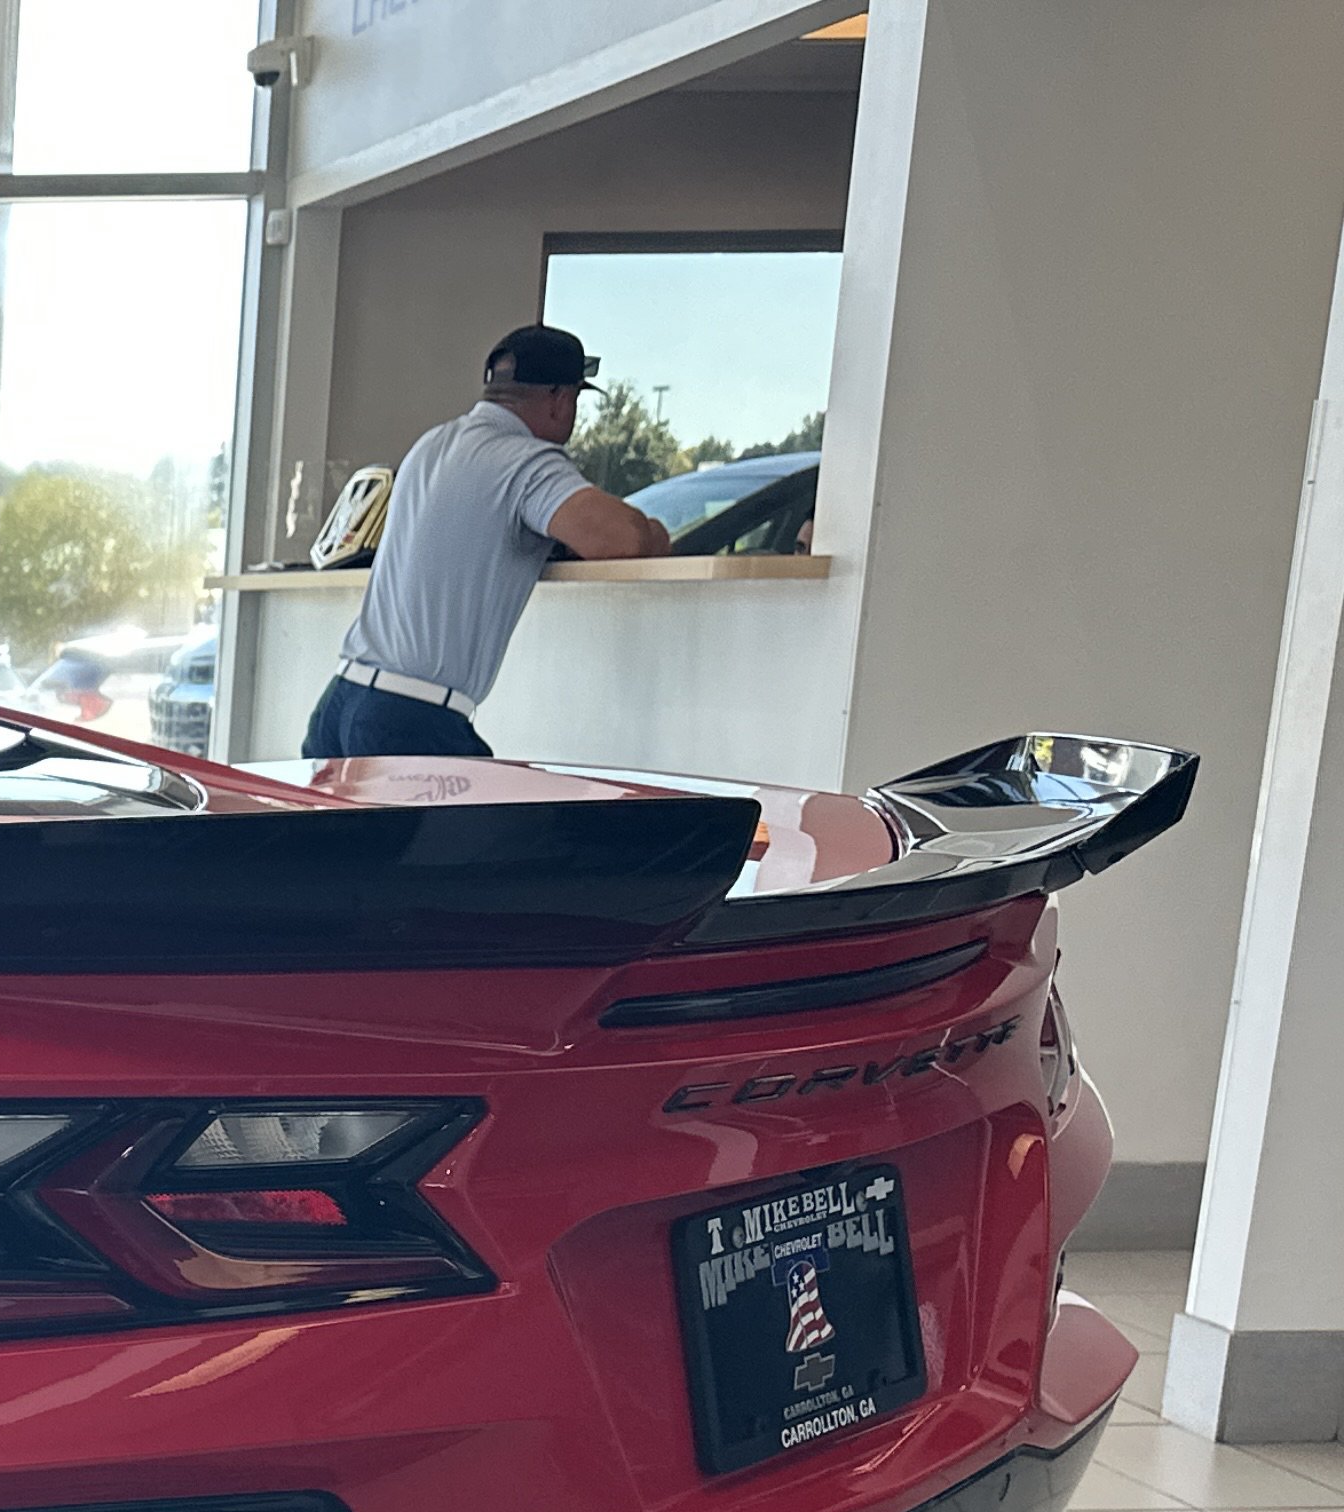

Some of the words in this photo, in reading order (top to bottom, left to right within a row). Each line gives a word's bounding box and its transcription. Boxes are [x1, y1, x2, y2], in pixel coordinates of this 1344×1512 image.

[742, 1196, 800, 1244] MIKE
[801, 1181, 856, 1216] BELL
[773, 1211, 827, 1233] CHEVROLET
[699, 1244, 771, 1311] MIKE
[827, 1208, 894, 1256] BELL
[774, 1232, 823, 1259] CHEVROLET
[841, 1384, 855, 1399] GA
[781, 1404, 859, 1448] CARROLLTON,
[859, 1397, 877, 1418] GA
